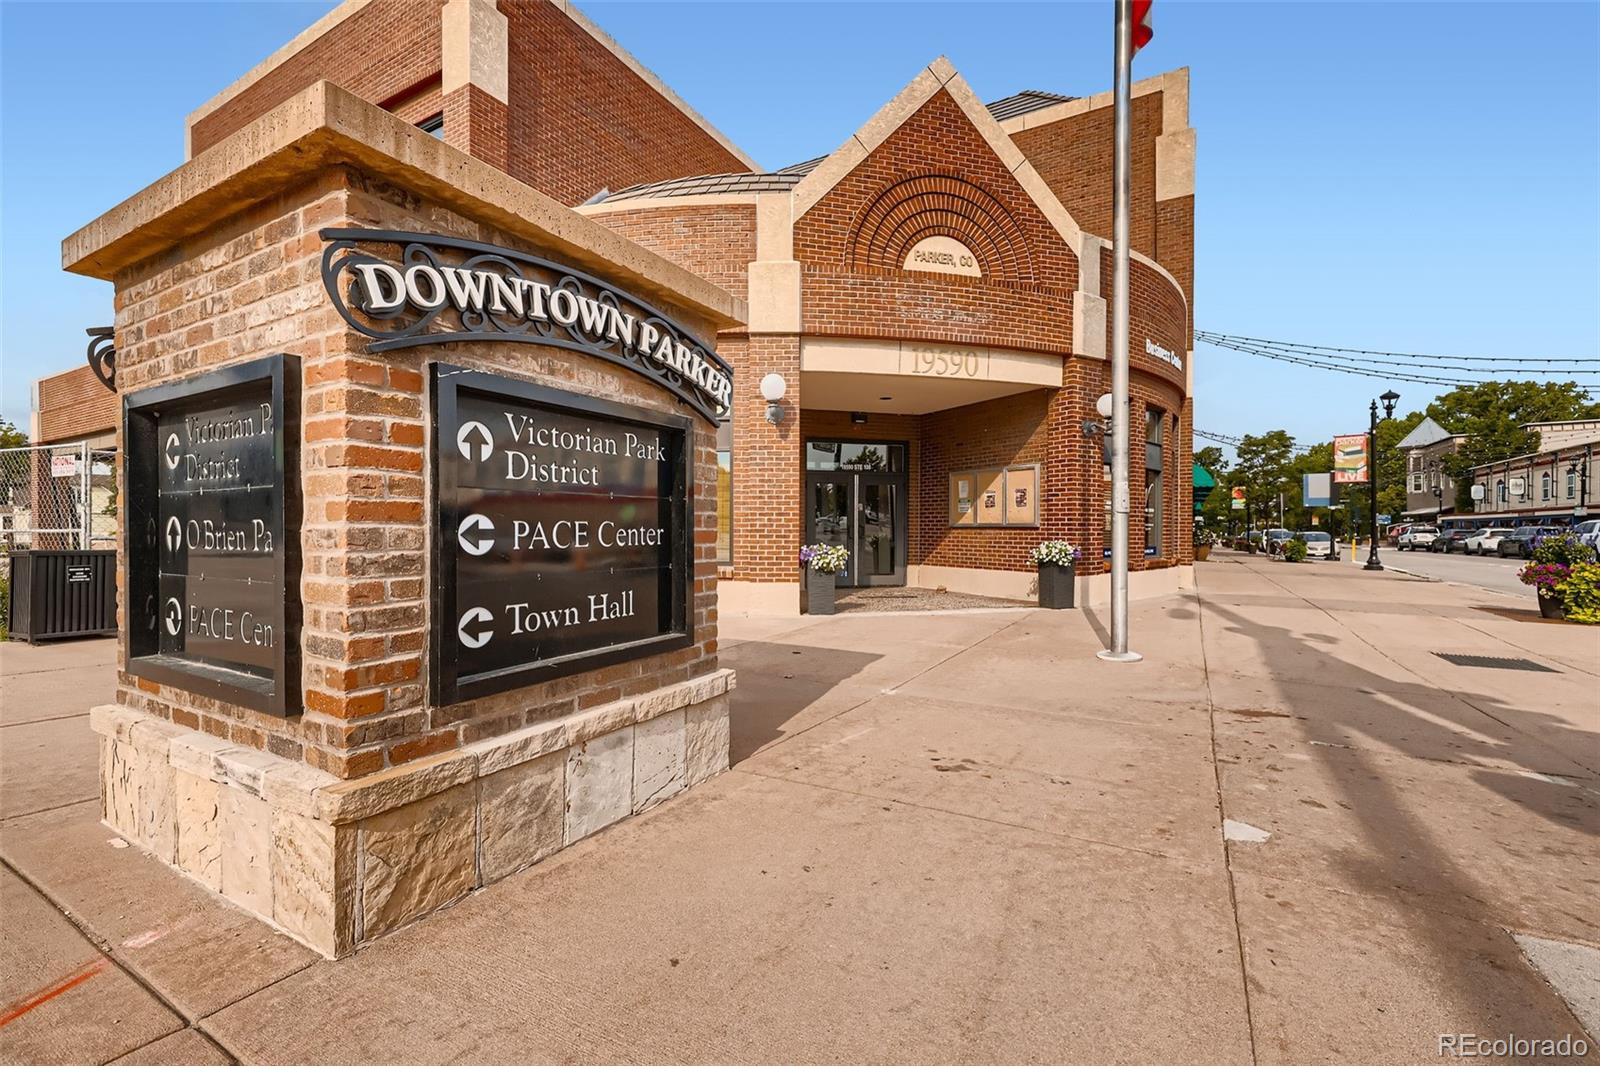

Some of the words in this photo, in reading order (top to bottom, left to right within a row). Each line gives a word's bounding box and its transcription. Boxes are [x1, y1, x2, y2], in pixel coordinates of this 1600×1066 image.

[914, 250, 957, 268] PARKER,
[959, 255, 974, 268] CO
[354, 262, 634, 348] DOWNTOWN
[639, 321, 732, 407] PARKER
[911, 347, 979, 377] 19590
[184, 408, 254, 447] Victorian
[503, 412, 618, 456] Victorian
[624, 432, 667, 462] Park
[184, 450, 241, 481] District
[504, 449, 600, 486] District
[512, 519, 590, 550] PACE
[597, 520, 665, 548] Center
[188, 604, 234, 641] PACE
[504, 602, 581, 636] Town
[587, 590, 635, 623] Hall
